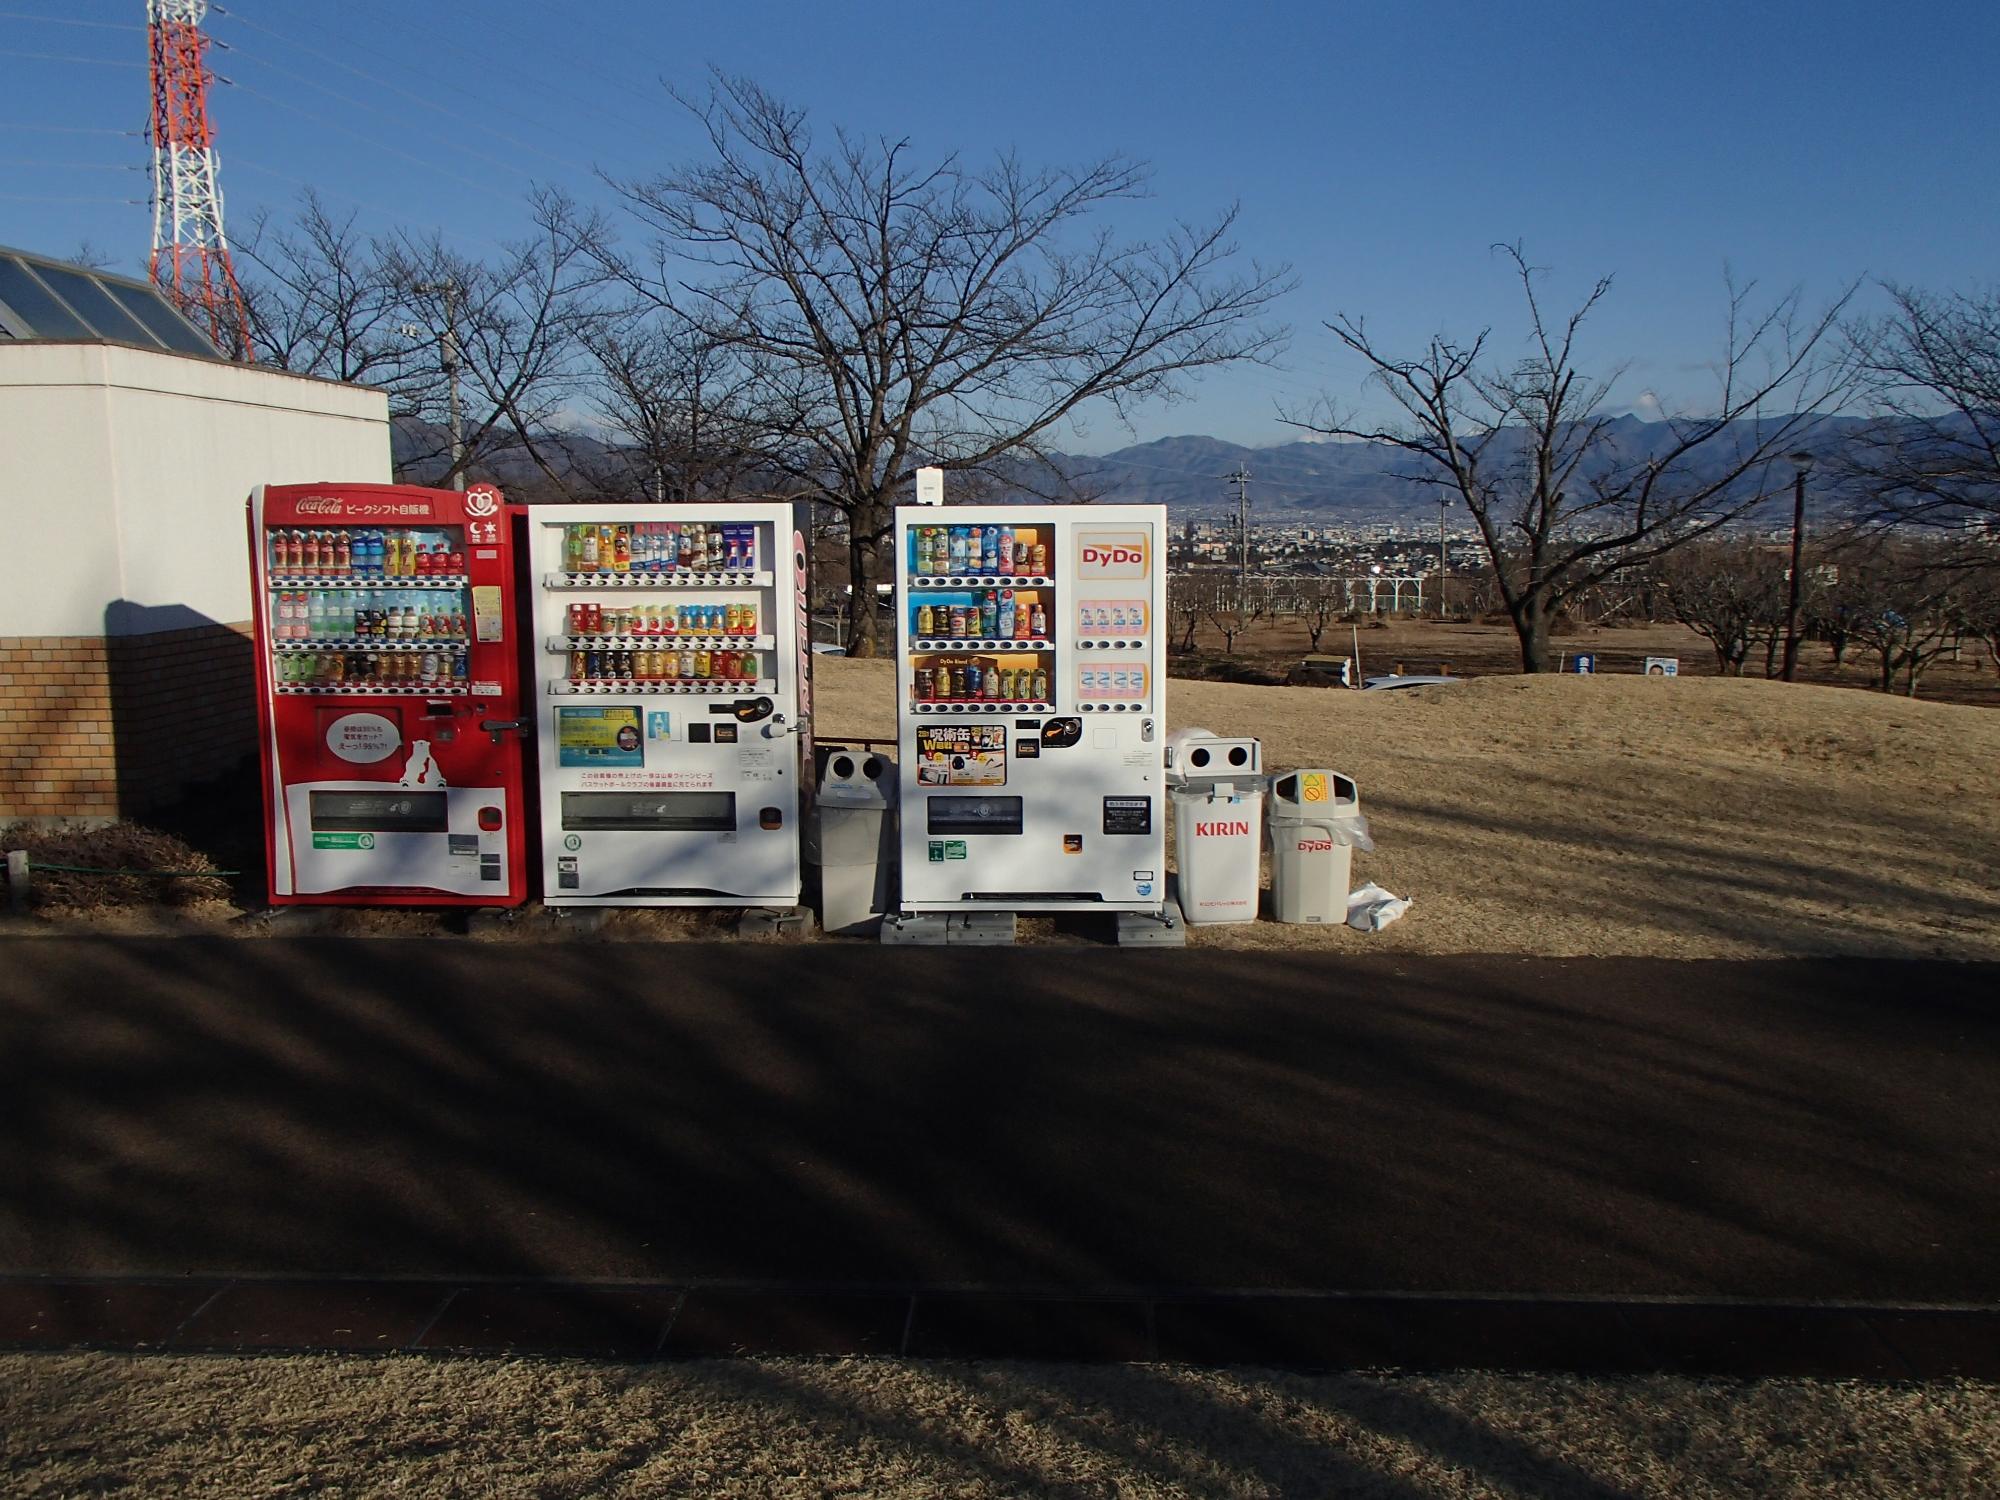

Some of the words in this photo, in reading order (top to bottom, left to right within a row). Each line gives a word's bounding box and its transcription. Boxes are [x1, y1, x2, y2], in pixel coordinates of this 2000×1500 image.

[1082, 548, 1143, 567] DyDo
[929, 728, 971, 742] 呪術缶
[1196, 821, 1249, 837] KIRIN
[1297, 841, 1332, 852] DyDo
